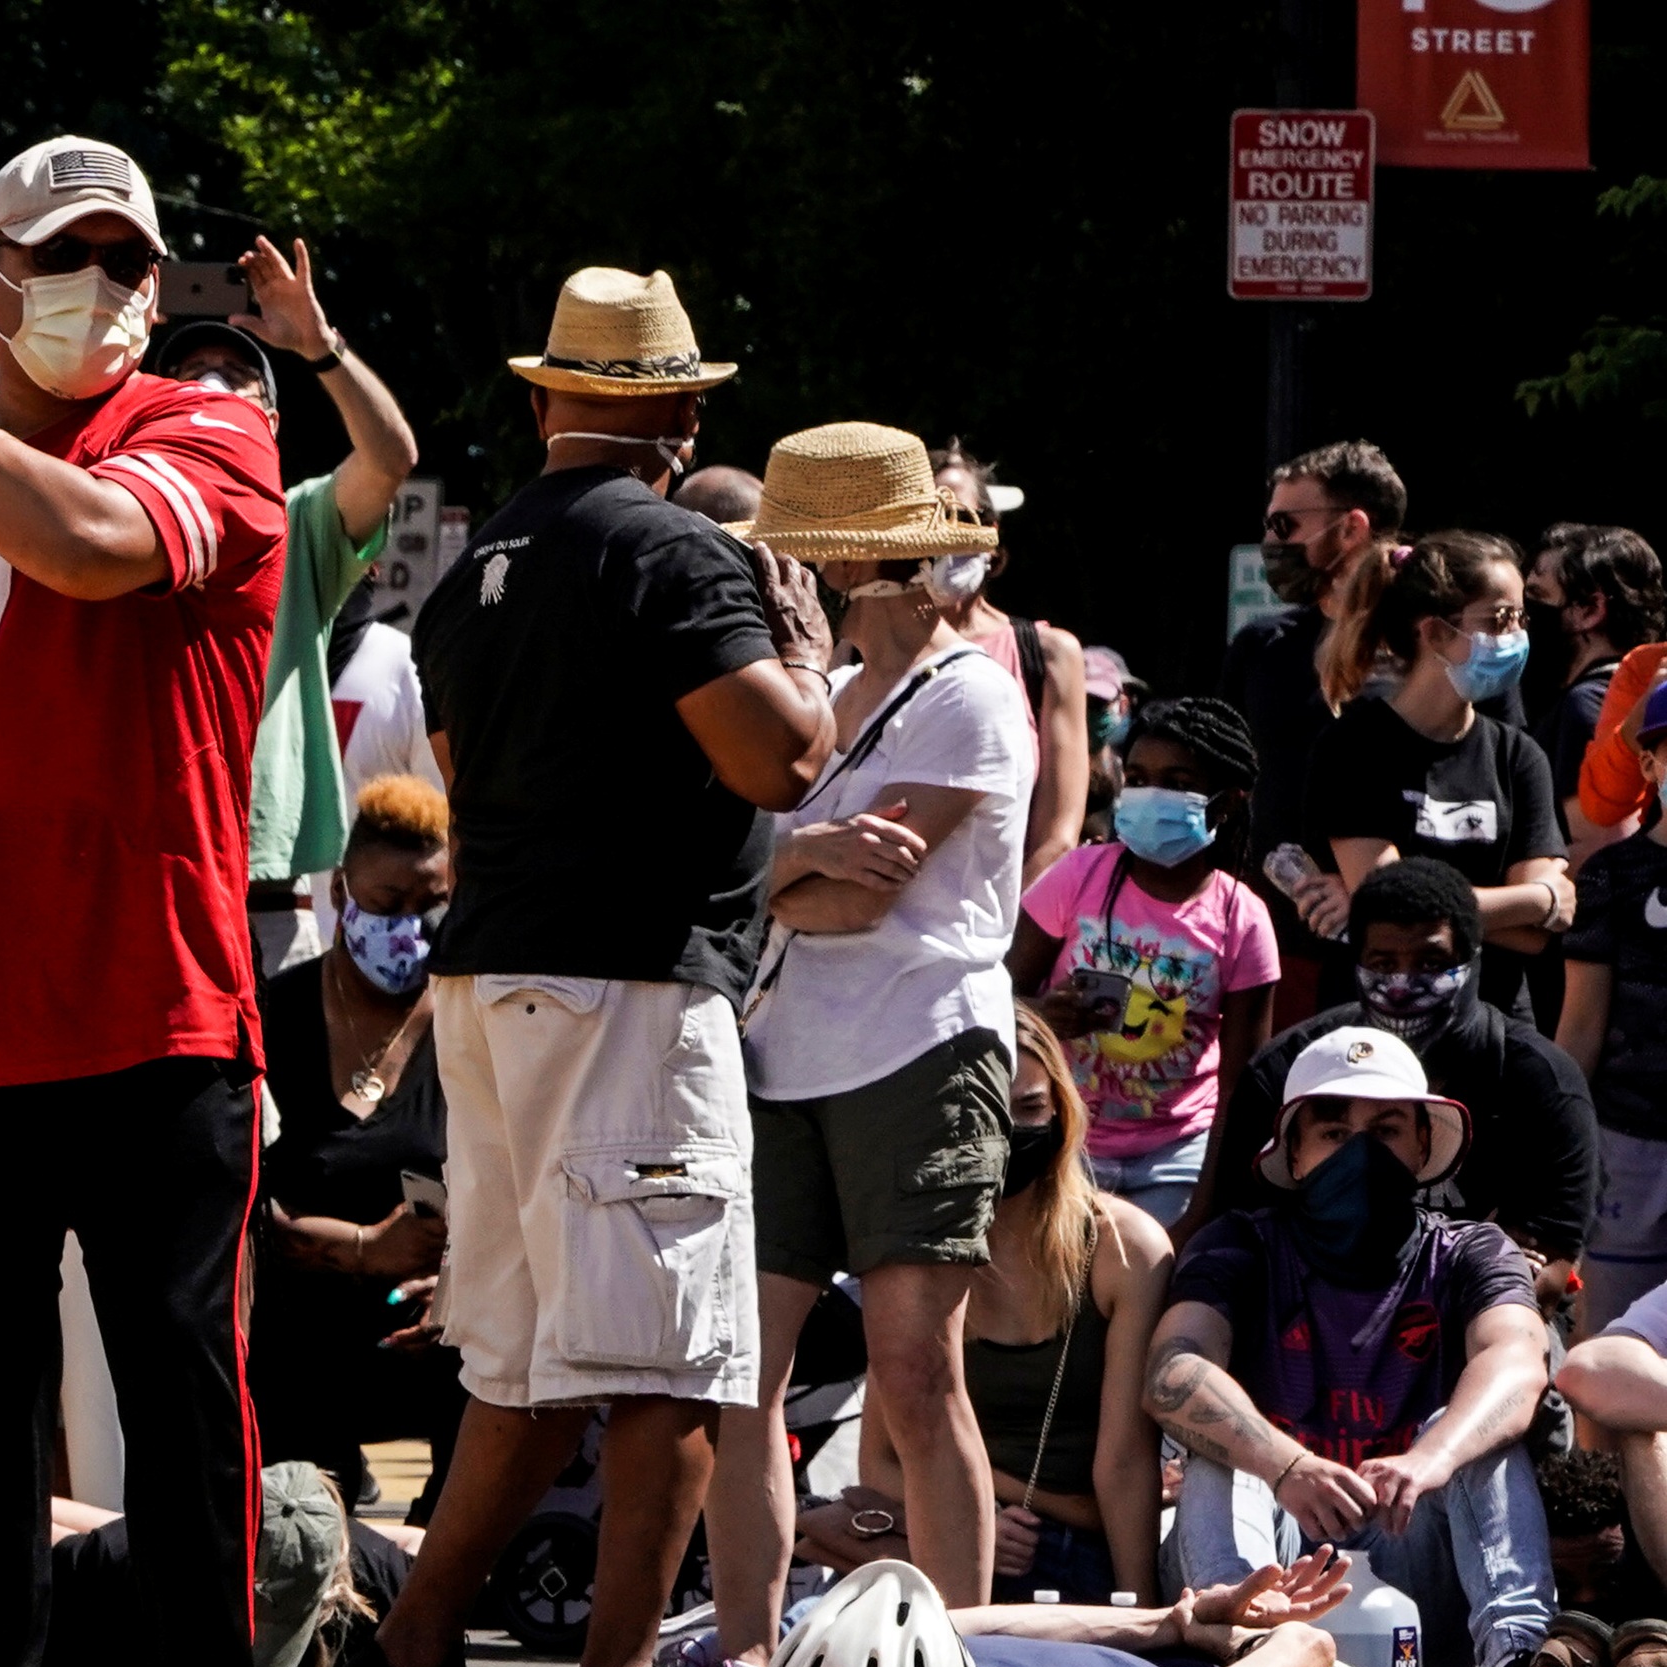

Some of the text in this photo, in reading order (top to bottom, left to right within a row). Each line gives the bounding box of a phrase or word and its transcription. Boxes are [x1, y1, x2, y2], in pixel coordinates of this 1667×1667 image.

[1410, 28, 1535, 54] STREET
[1258, 120, 1346, 147] SNOW
[1239, 149, 1364, 169] EMERGENCY
[1248, 171, 1355, 199] ROUTE
[1240, 205, 1363, 227] NO PARKING
[1264, 231, 1338, 252] DURING
[1239, 255, 1362, 277] EMERGENCY
[1331, 1389, 1384, 1429] Fly
